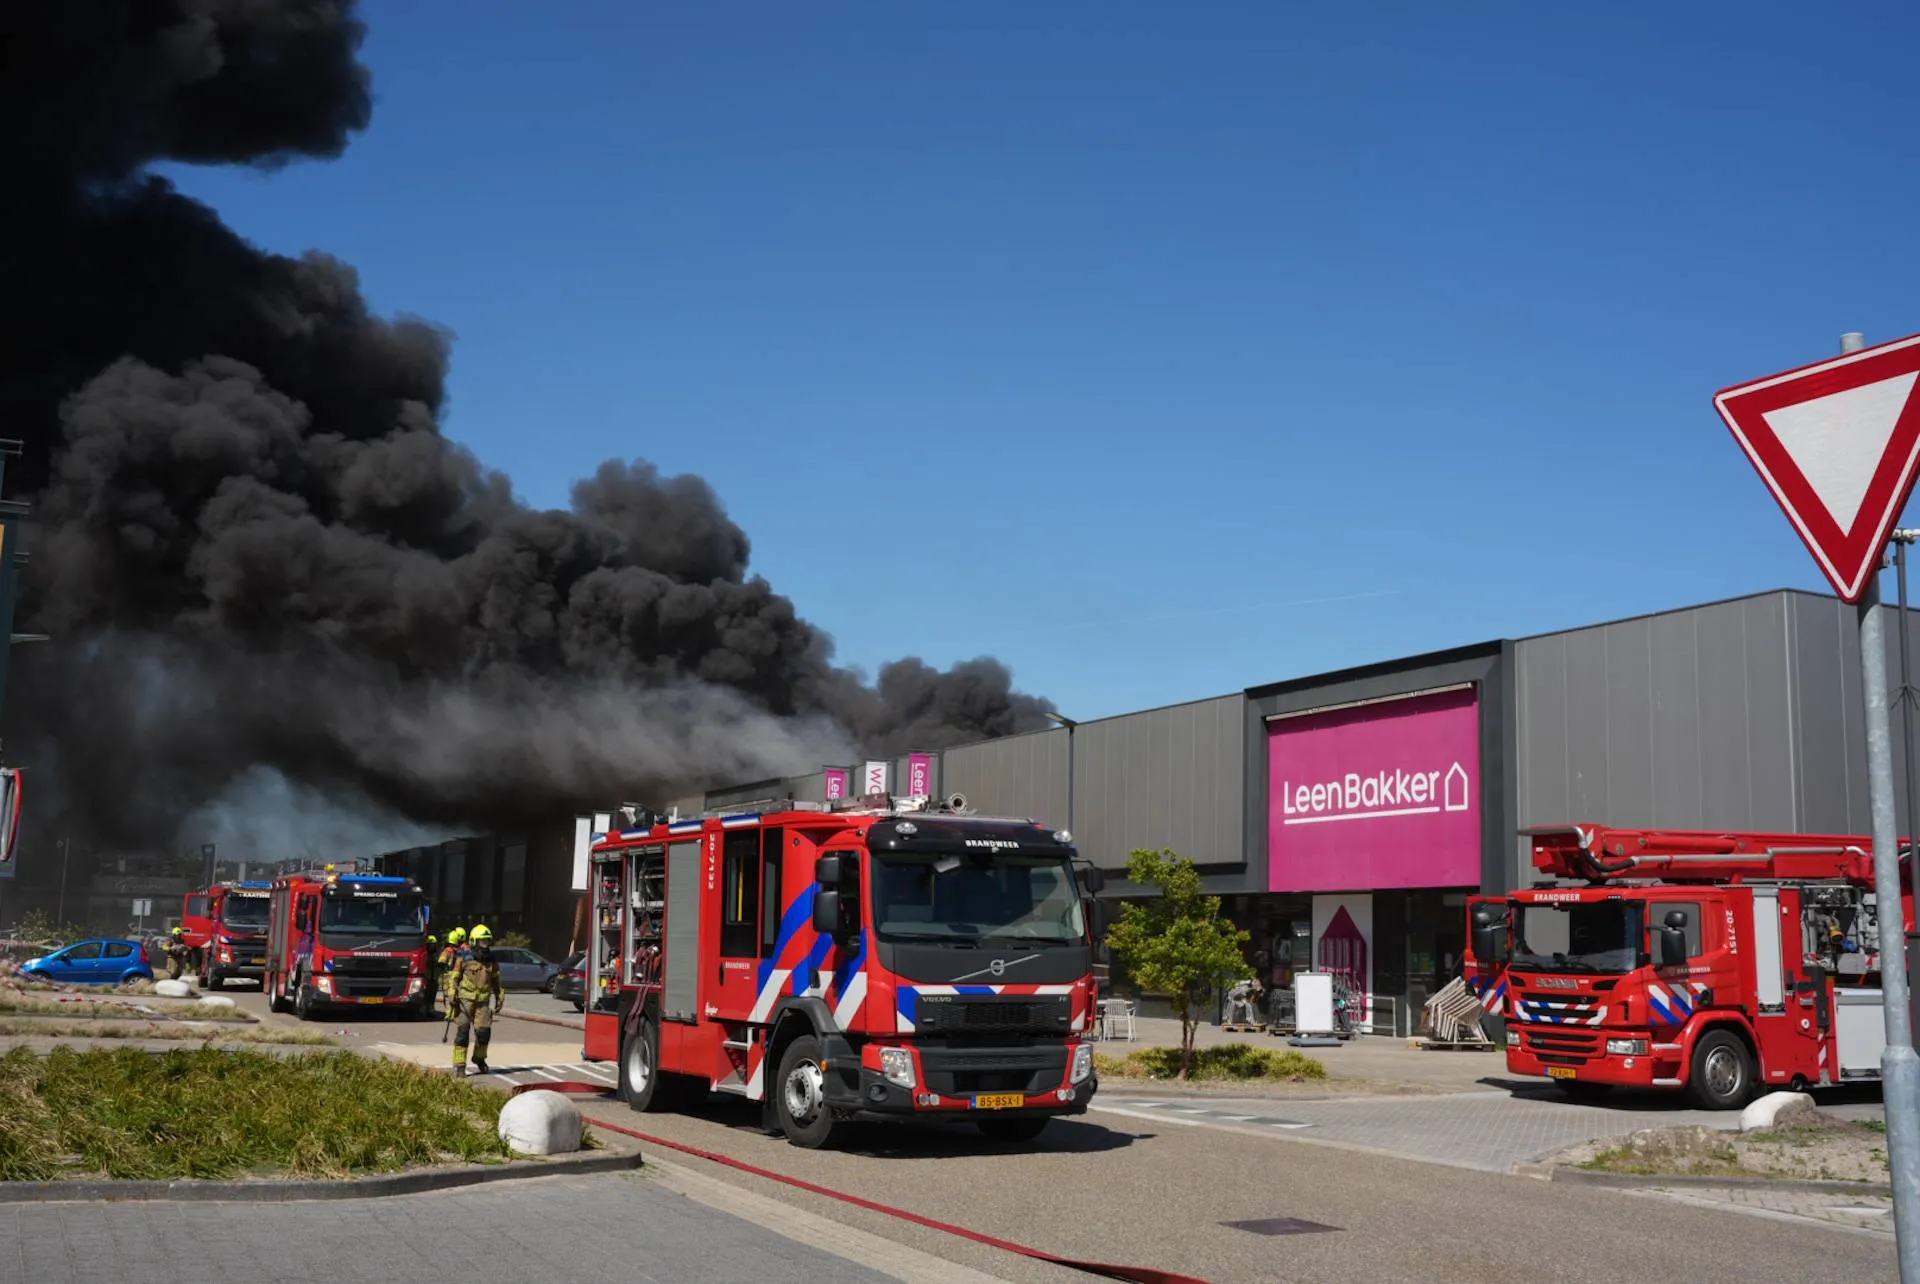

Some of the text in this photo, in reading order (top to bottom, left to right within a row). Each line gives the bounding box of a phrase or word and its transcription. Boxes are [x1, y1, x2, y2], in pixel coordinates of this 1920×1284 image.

[1284, 768, 1440, 815] LeenBakker
[965, 839, 1020, 848] BRANDWEER
[1534, 893, 1581, 902] BRANDWEER
[1535, 977, 1579, 990] SCANIA
